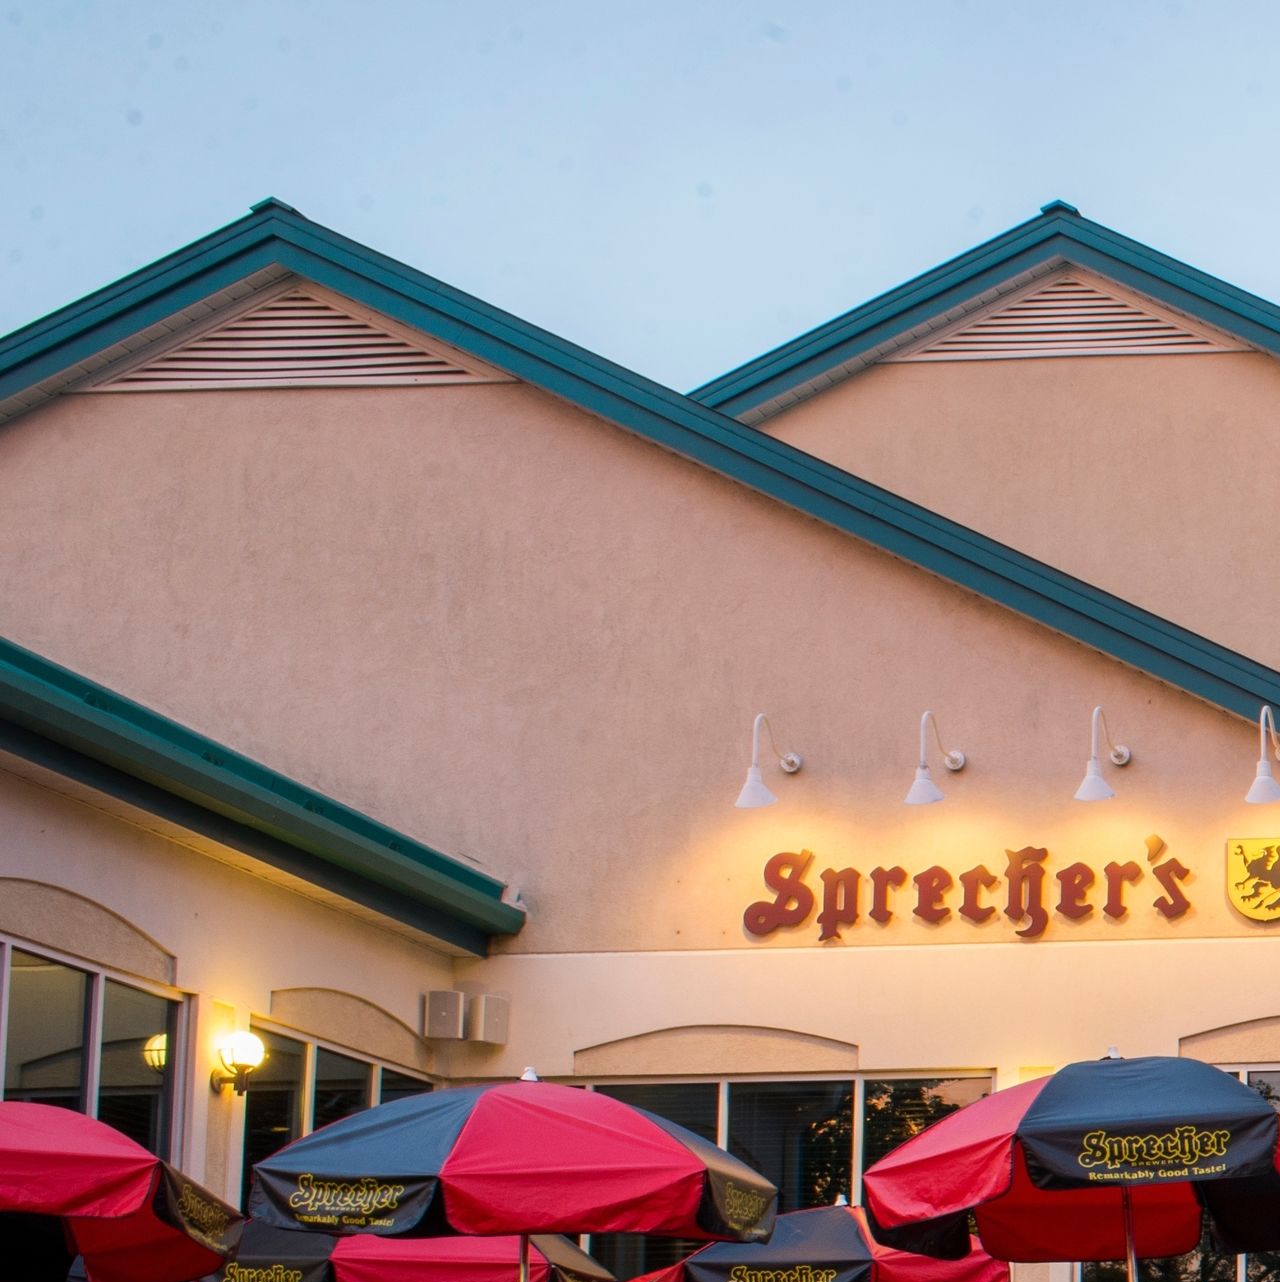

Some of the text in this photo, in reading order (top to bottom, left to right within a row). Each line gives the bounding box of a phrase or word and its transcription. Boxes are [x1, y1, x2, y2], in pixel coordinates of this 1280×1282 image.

[743, 834, 1190, 940] Sprecher's
[1078, 1126, 1231, 1169] Sprecher
[1089, 1164, 1226, 1181] Remarkably Good Taste!
[1131, 1159, 1180, 1167] BREWERY
[289, 1173, 405, 1214] Sprecher
[342, 1216, 366, 1226] Good
